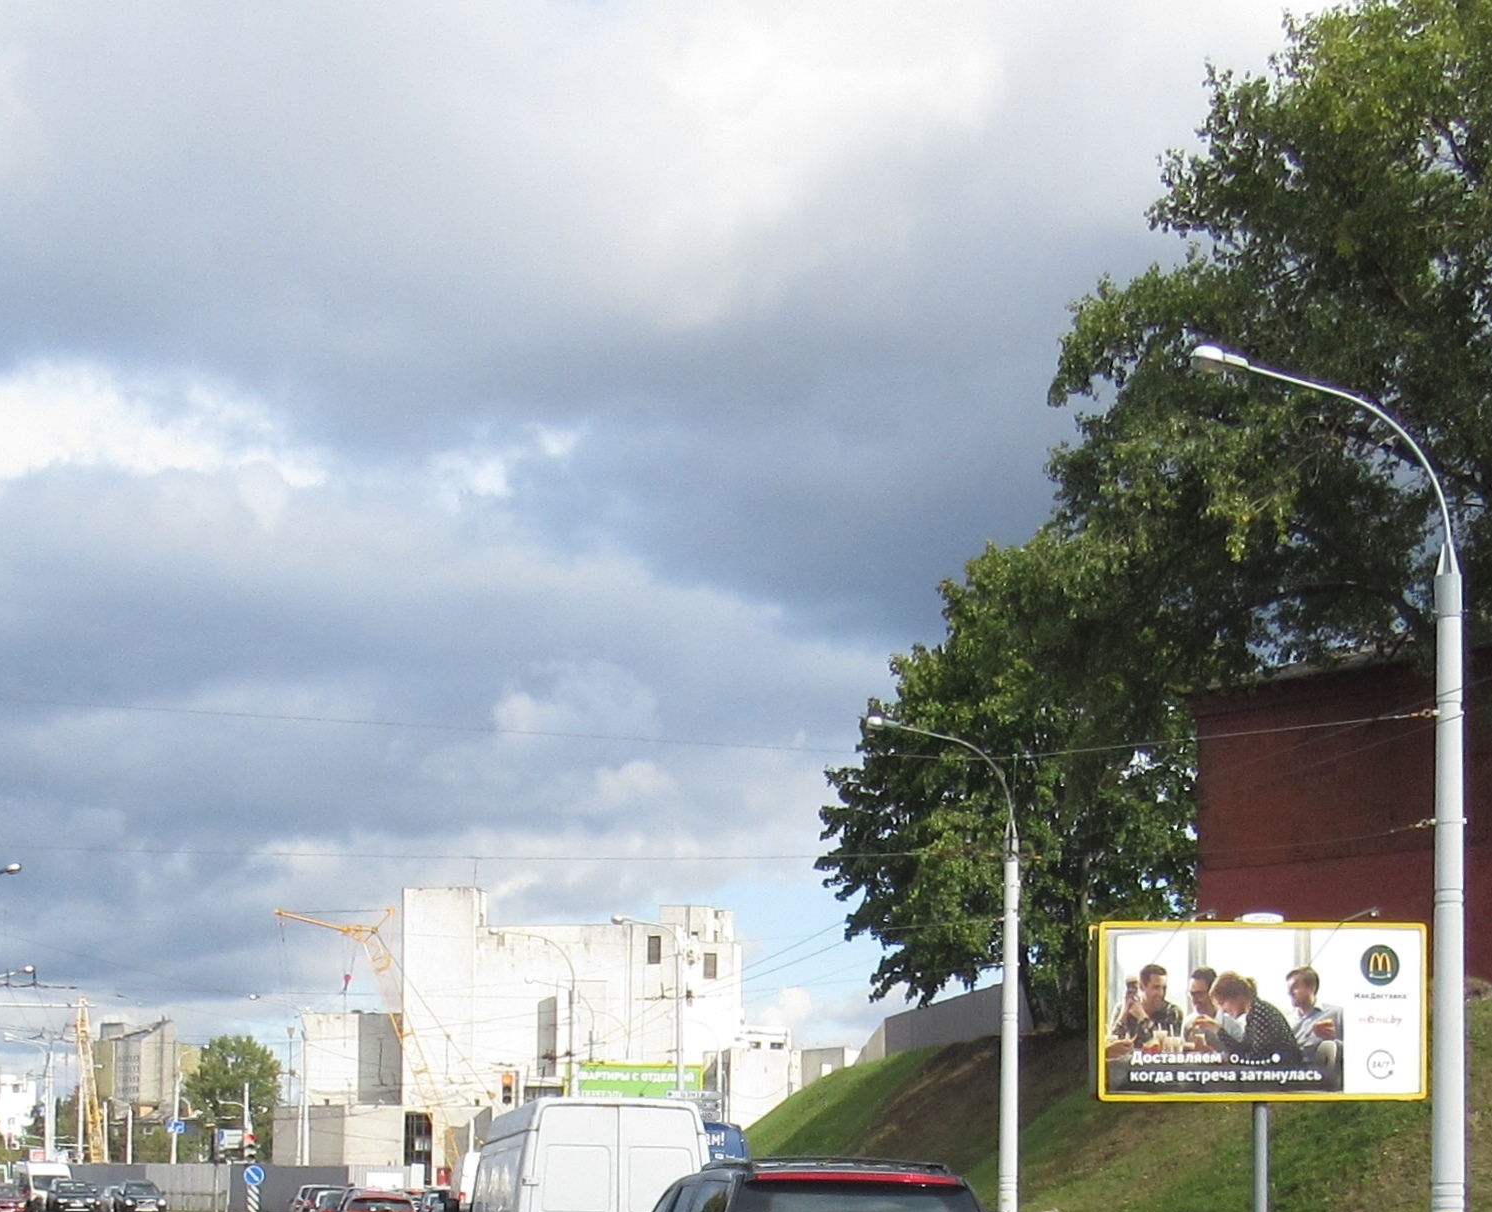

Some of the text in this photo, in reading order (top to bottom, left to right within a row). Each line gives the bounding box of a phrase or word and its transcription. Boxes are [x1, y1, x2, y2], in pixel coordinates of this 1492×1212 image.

[1130, 1051, 1222, 1066] Доставляем
[1129, 1069, 1322, 1085] когда встреча затянулась
